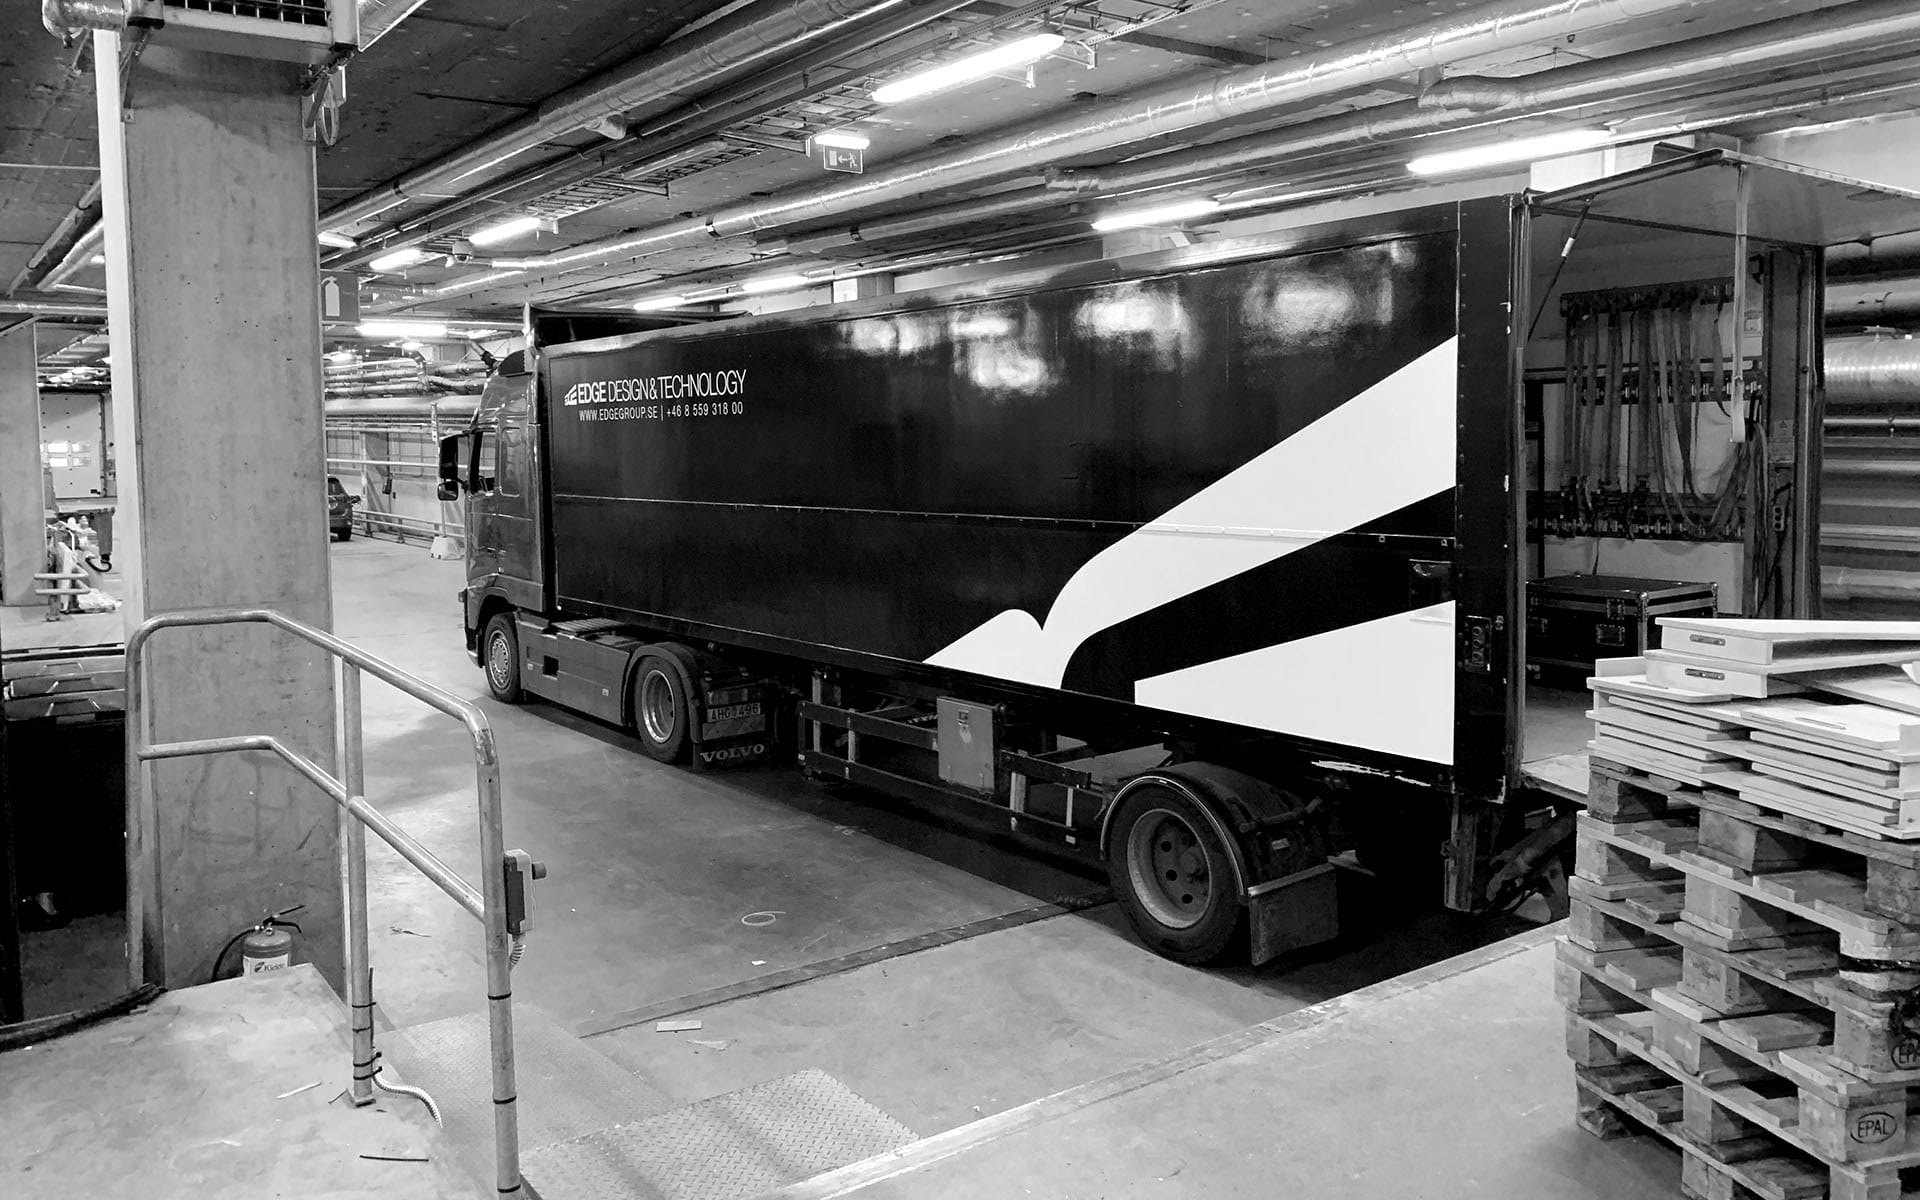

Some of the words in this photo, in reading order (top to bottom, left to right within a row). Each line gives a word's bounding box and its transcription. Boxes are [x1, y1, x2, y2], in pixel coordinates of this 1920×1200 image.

[578, 381, 607, 404] EDGE
[579, 405, 658, 421] WWW.EDGEGROUP.SE
[666, 404, 682, 417] +46
[684, 404, 690, 417] 8
[692, 403, 709, 416] 559
[712, 401, 729, 416] 318
[731, 401, 743, 415] 00
[699, 743, 765, 763] VOLVO
[1857, 1119, 1889, 1138] EPAL
